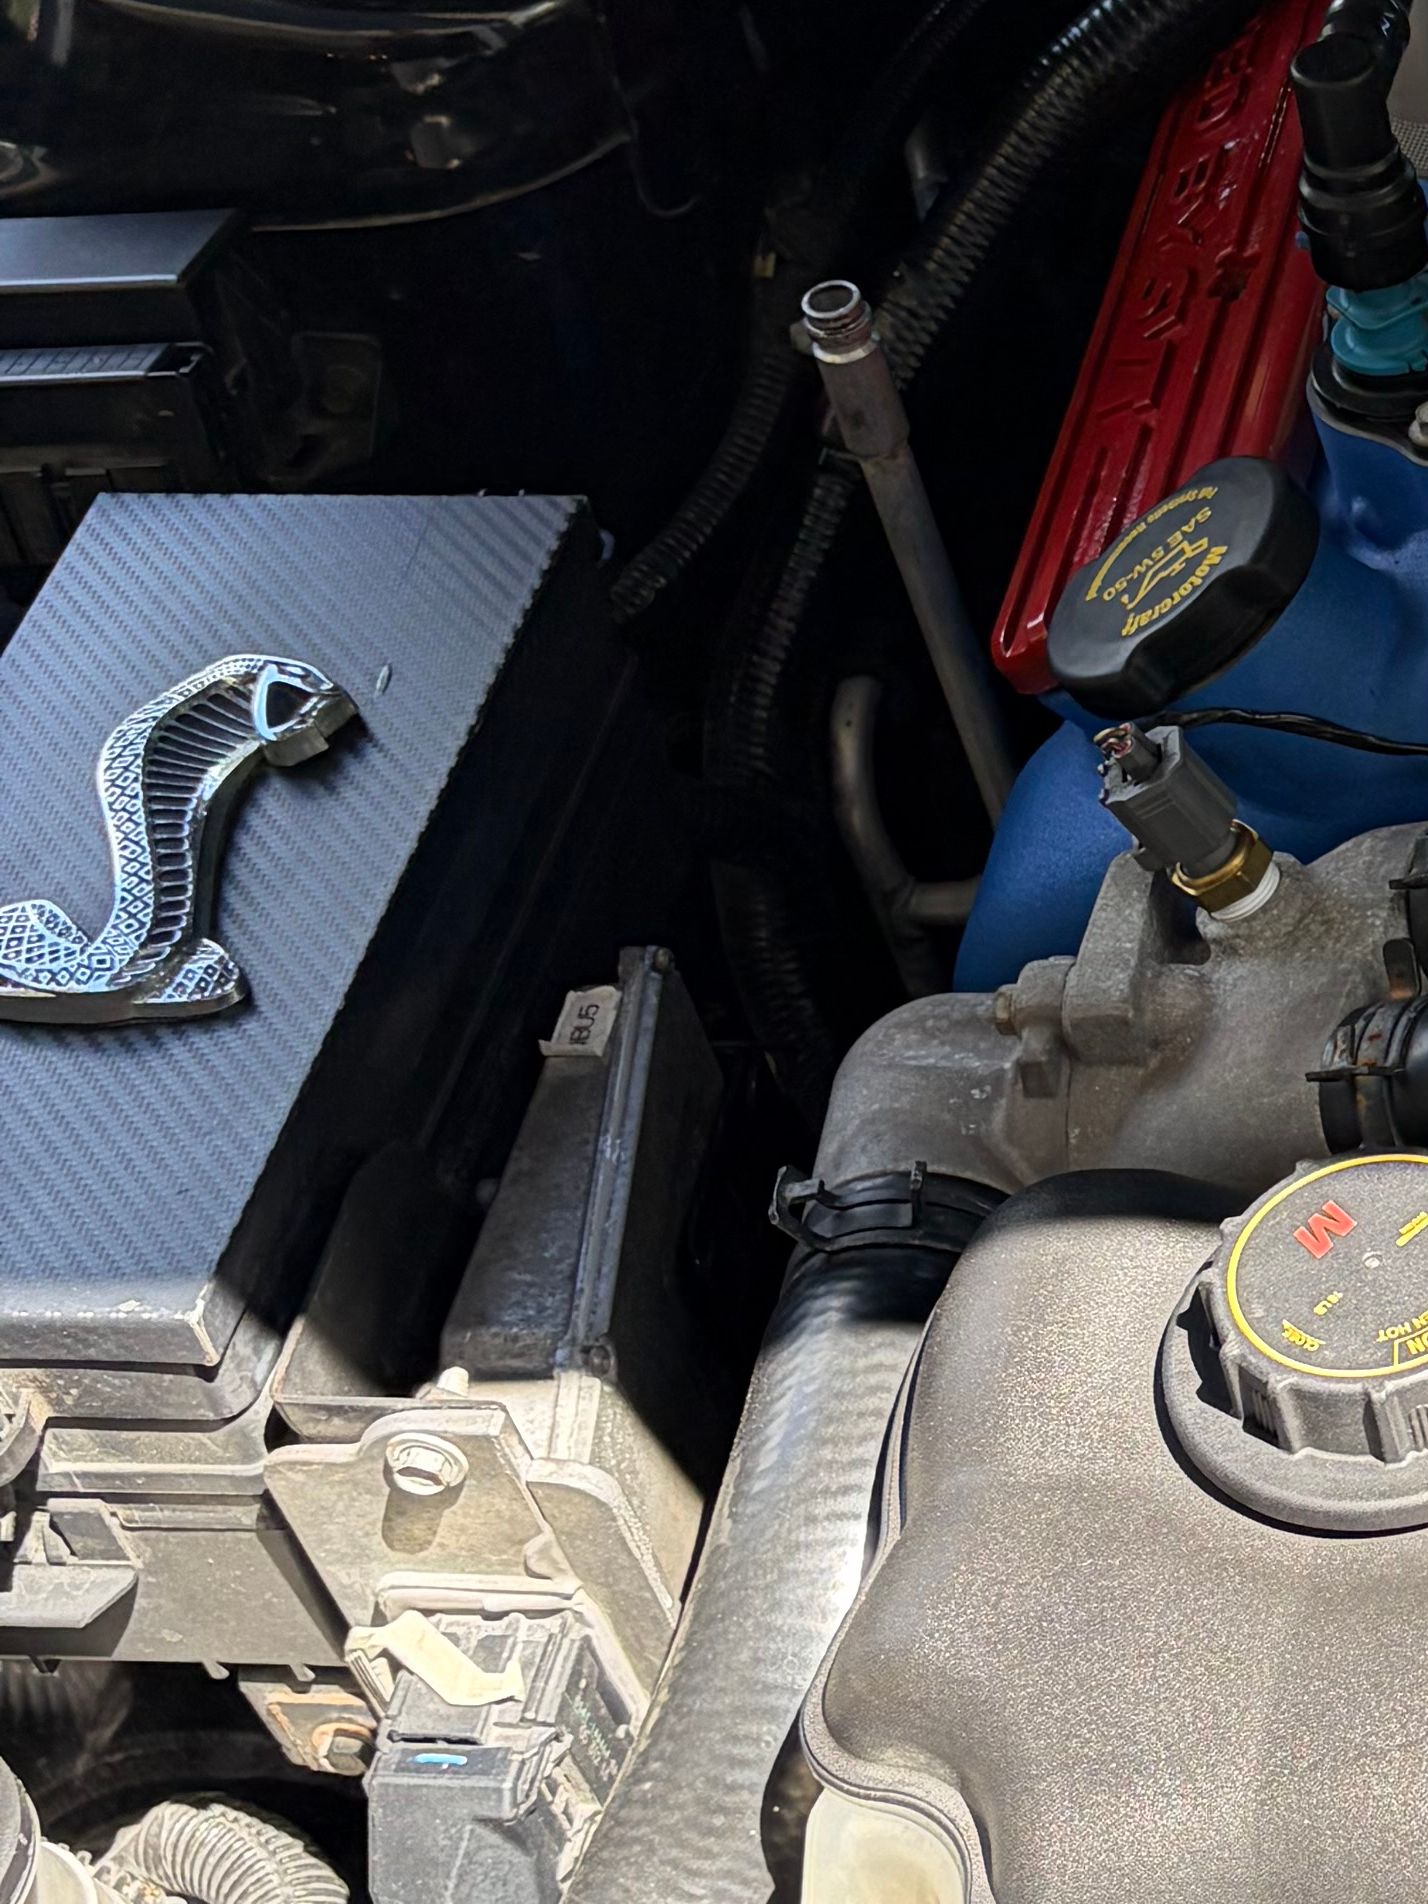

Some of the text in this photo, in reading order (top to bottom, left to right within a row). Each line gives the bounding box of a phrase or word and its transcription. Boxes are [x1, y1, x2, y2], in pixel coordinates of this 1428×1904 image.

[1165, 506, 1212, 549] SAE
[1121, 545, 1228, 637] Motorcraft
[1377, 1320, 1413, 1344] HOT
